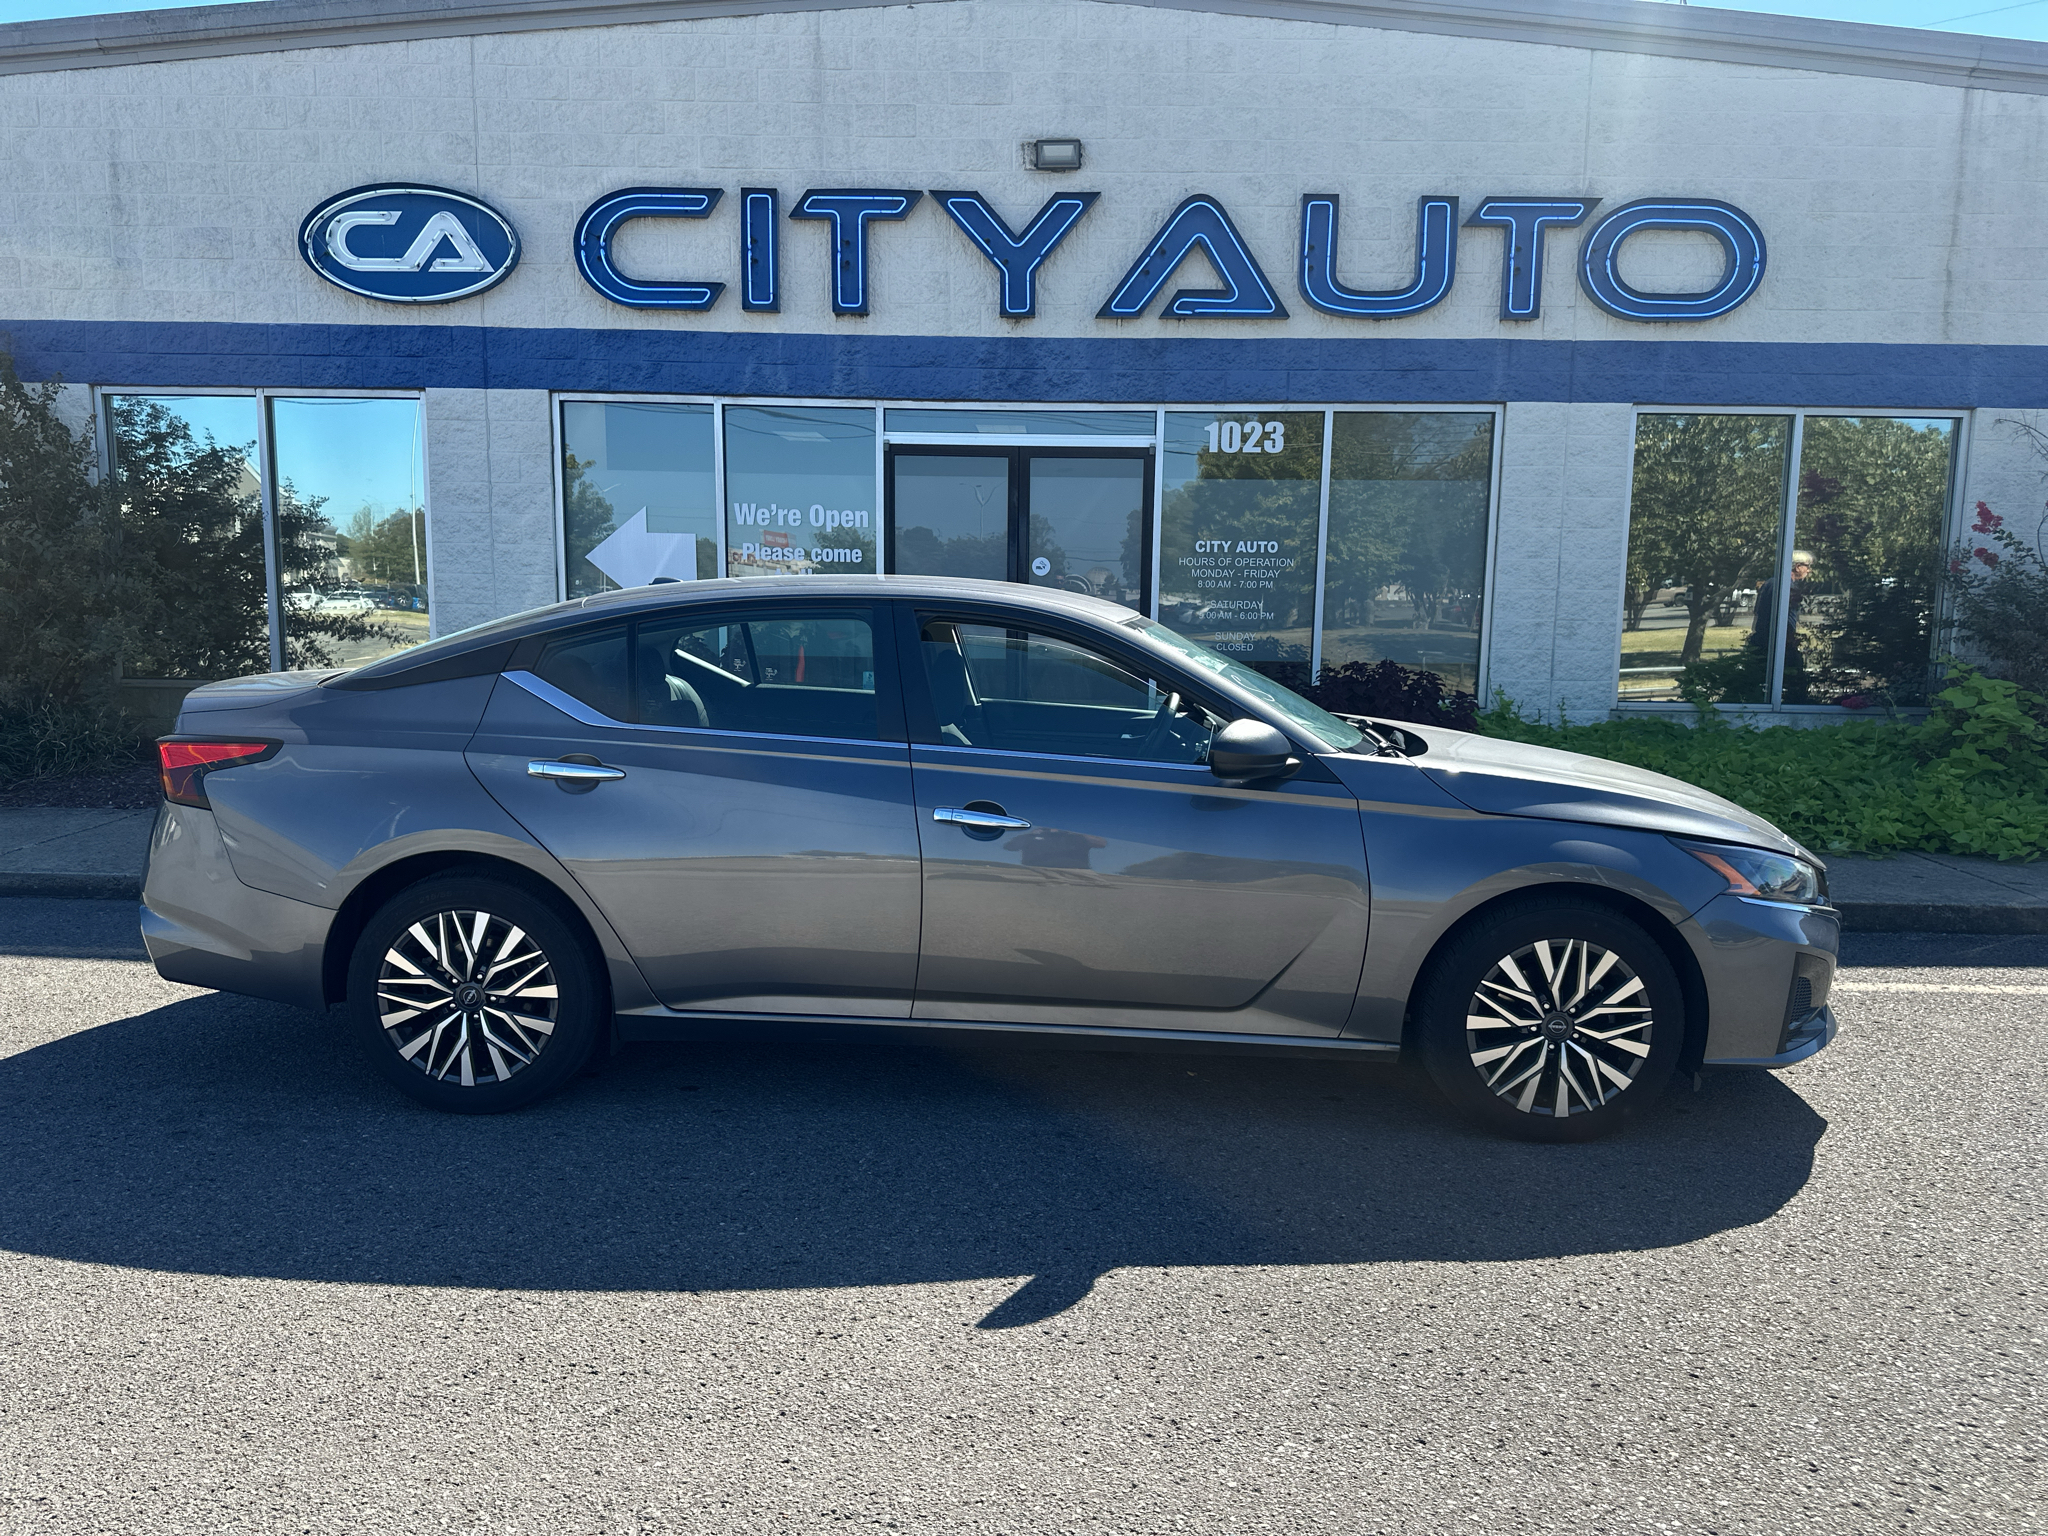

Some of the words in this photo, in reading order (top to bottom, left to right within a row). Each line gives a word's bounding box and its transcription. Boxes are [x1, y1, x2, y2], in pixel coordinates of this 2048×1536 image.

[326, 211, 495, 272] CA
[574, 187, 1101, 318] CITY
[1096, 193, 1767, 322] AUTO
[1204, 421, 1285, 454] 1023
[734, 503, 802, 527] We're
[809, 504, 869, 532] Open
[1195, 540, 1232, 553] CITY
[1236, 541, 1279, 554] AUTO
[742, 543, 805, 560] Please
[811, 548, 863, 563] come
[1178, 557, 1216, 567] HOURS
[1218, 557, 1232, 566] OF
[1235, 558, 1294, 567] OPERATION
[1191, 569, 1235, 578] MONDAY
[1243, 569, 1280, 578] FRIDAY
[1197, 580, 1216, 588] 8:00
[1217, 580, 1231, 588] AM
[1239, 580, 1257, 588] 7:00
[1259, 581, 1274, 589] PM
[1210, 600, 1264, 610] SATURDAY
[1218, 611, 1232, 619] AM
[1239, 611, 1258, 620] 6:00
[1260, 612, 1274, 620] PM
[1214, 632, 1257, 641] SUNDAY
[1216, 643, 1254, 651] CLOSED
